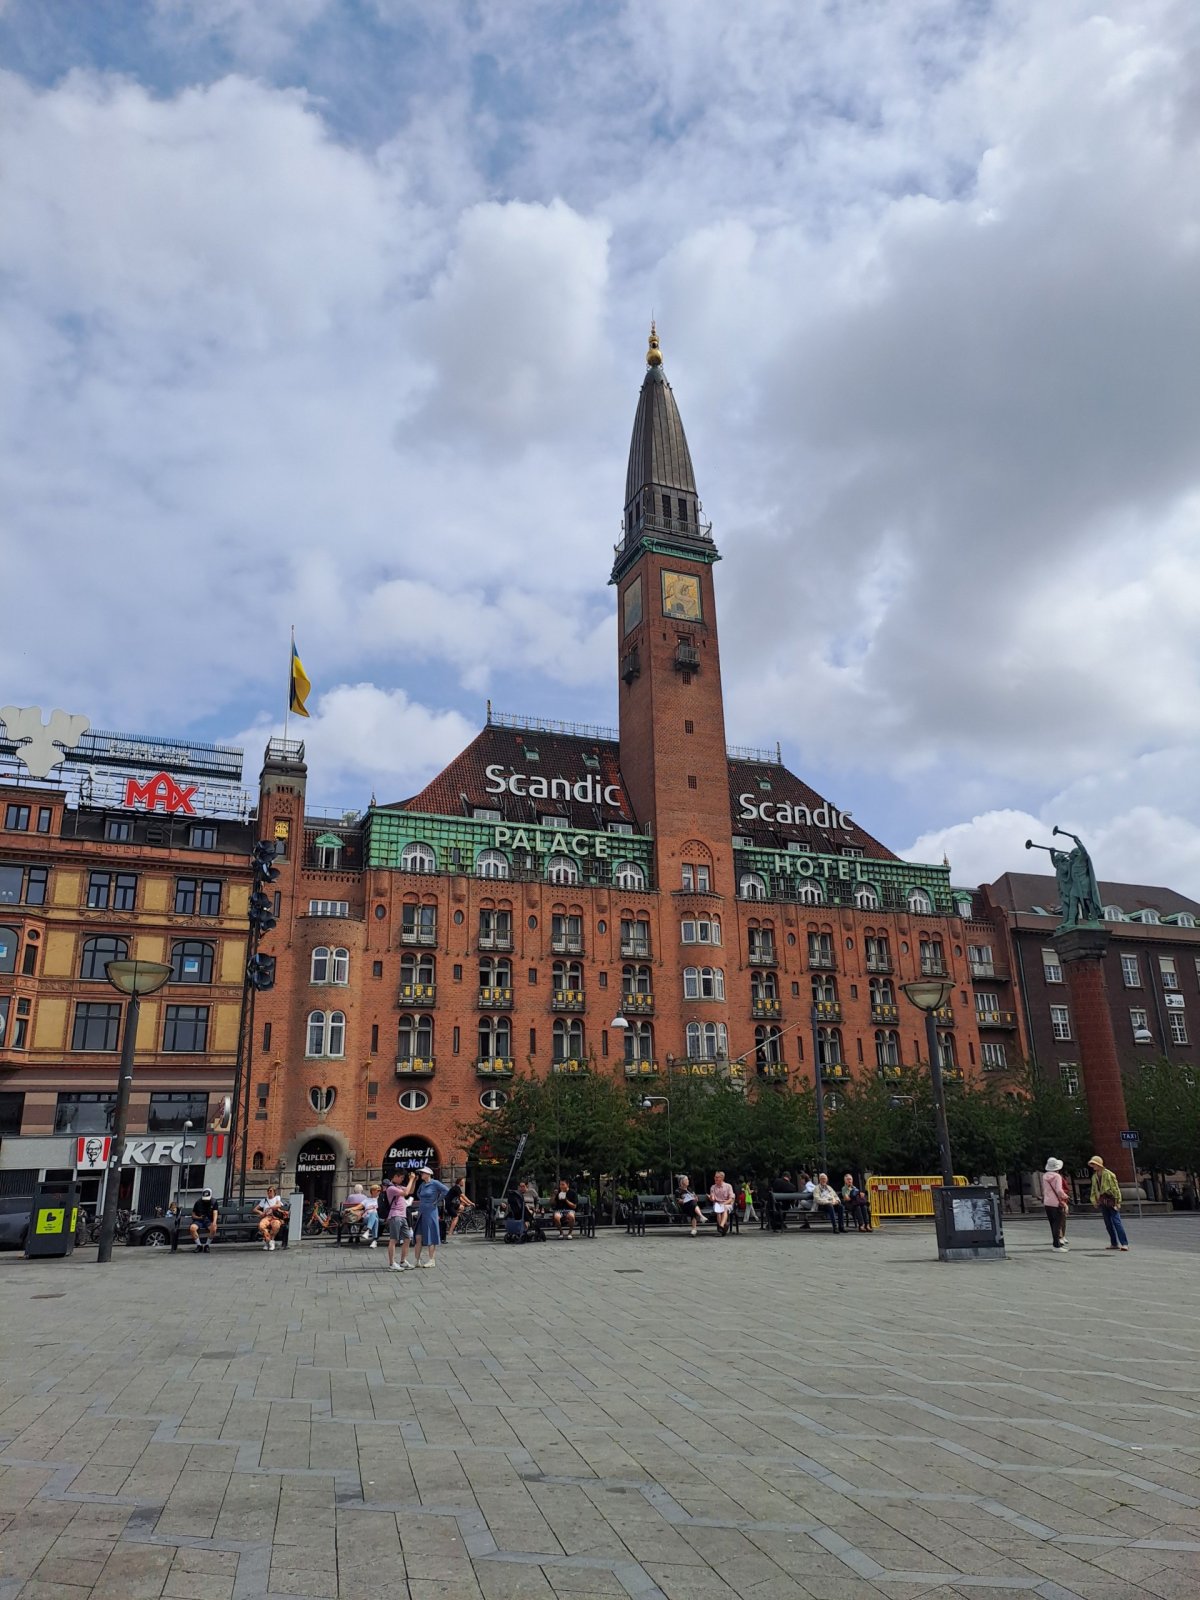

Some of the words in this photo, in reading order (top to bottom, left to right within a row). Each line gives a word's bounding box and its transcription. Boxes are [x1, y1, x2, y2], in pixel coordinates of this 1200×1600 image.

[124, 770, 198, 815] MAX
[485, 764, 621, 806] Scandic
[739, 793, 854, 831] Scandic
[494, 826, 609, 858] PALACE
[774, 854, 869, 882] HOTEL
[121, 1141, 197, 1164] KFC
[388, 1147, 423, 1158] Believe
[424, 1147, 434, 1157] It
[407, 1157, 429, 1168] Not!
[297, 1164, 336, 1172] Museum
